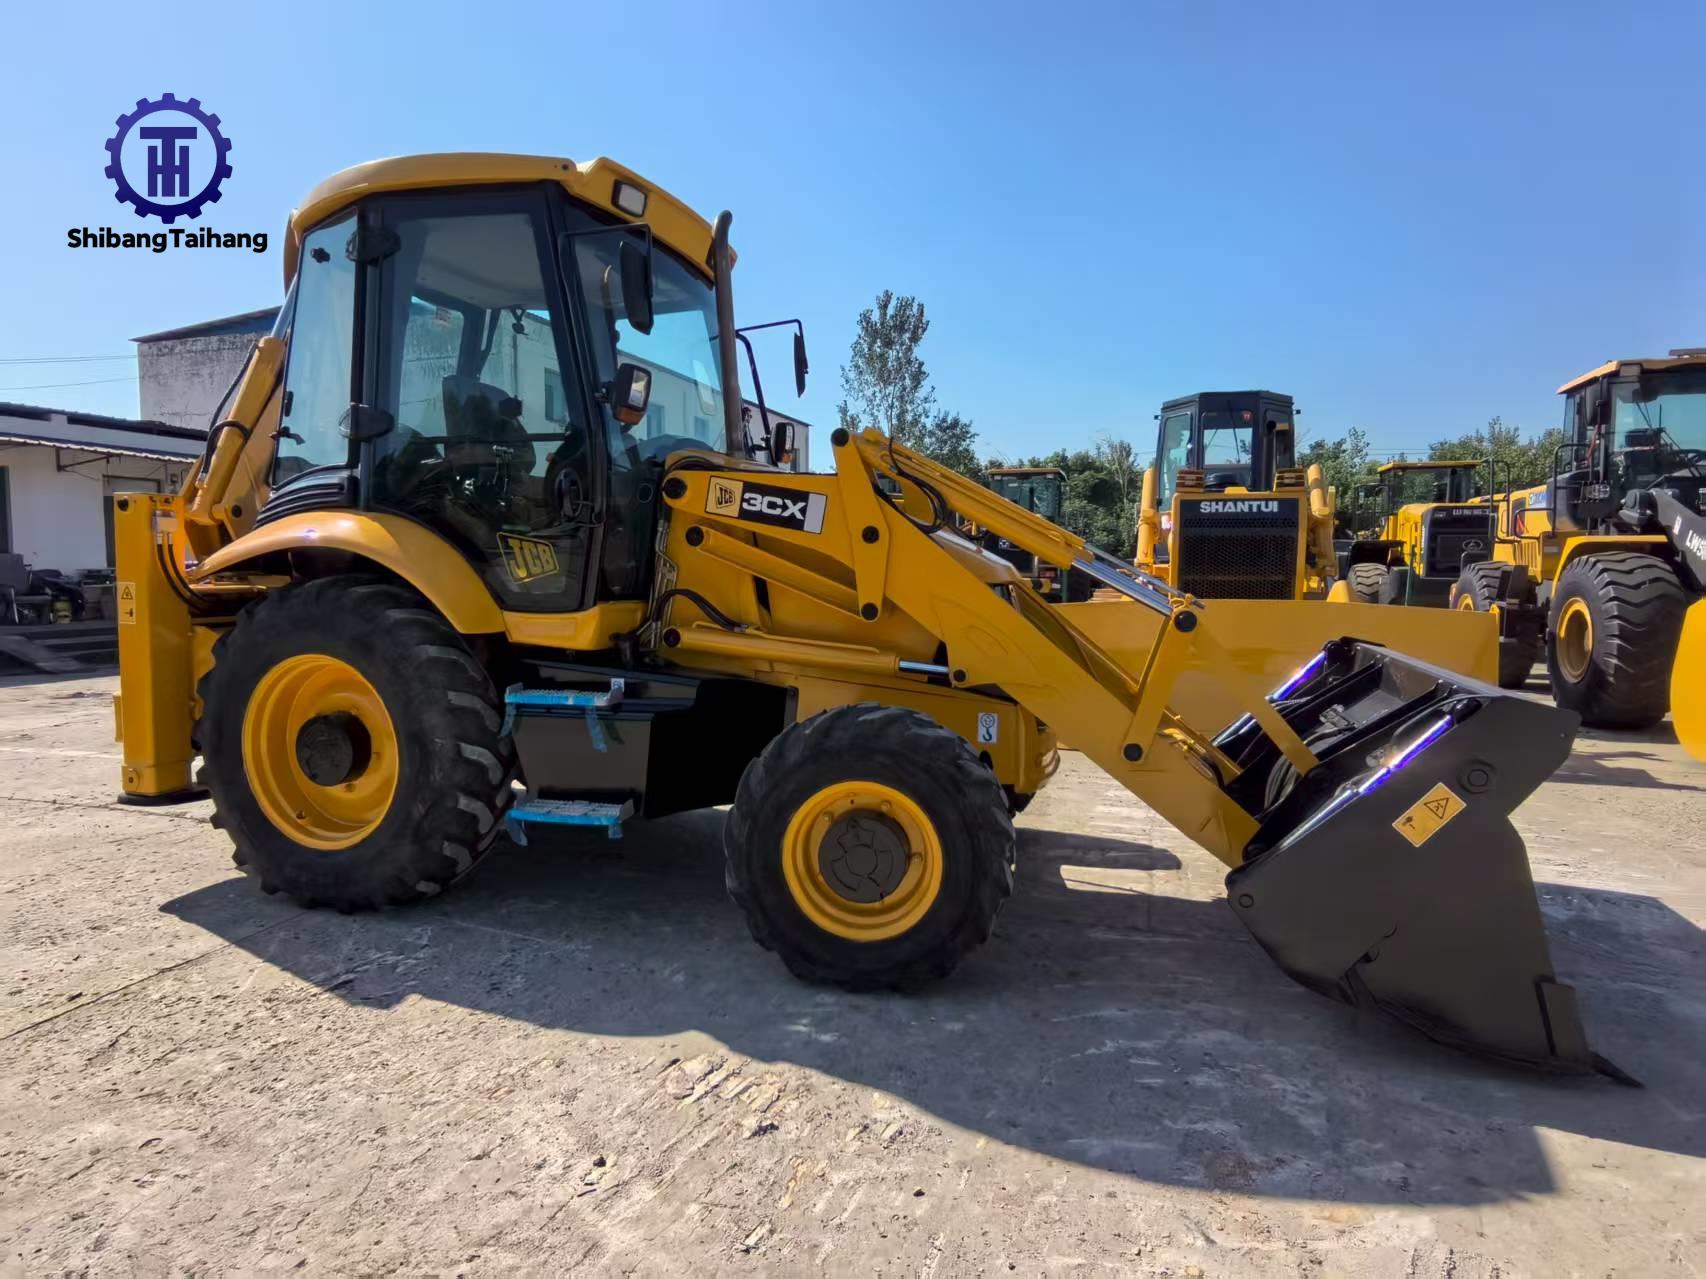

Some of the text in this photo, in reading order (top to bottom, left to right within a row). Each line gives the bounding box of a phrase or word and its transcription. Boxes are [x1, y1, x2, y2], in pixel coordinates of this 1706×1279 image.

[717, 483, 807, 520] JCB 3CX
[1200, 501, 1279, 513] SHANTUI
[507, 537, 557, 578] JCB
